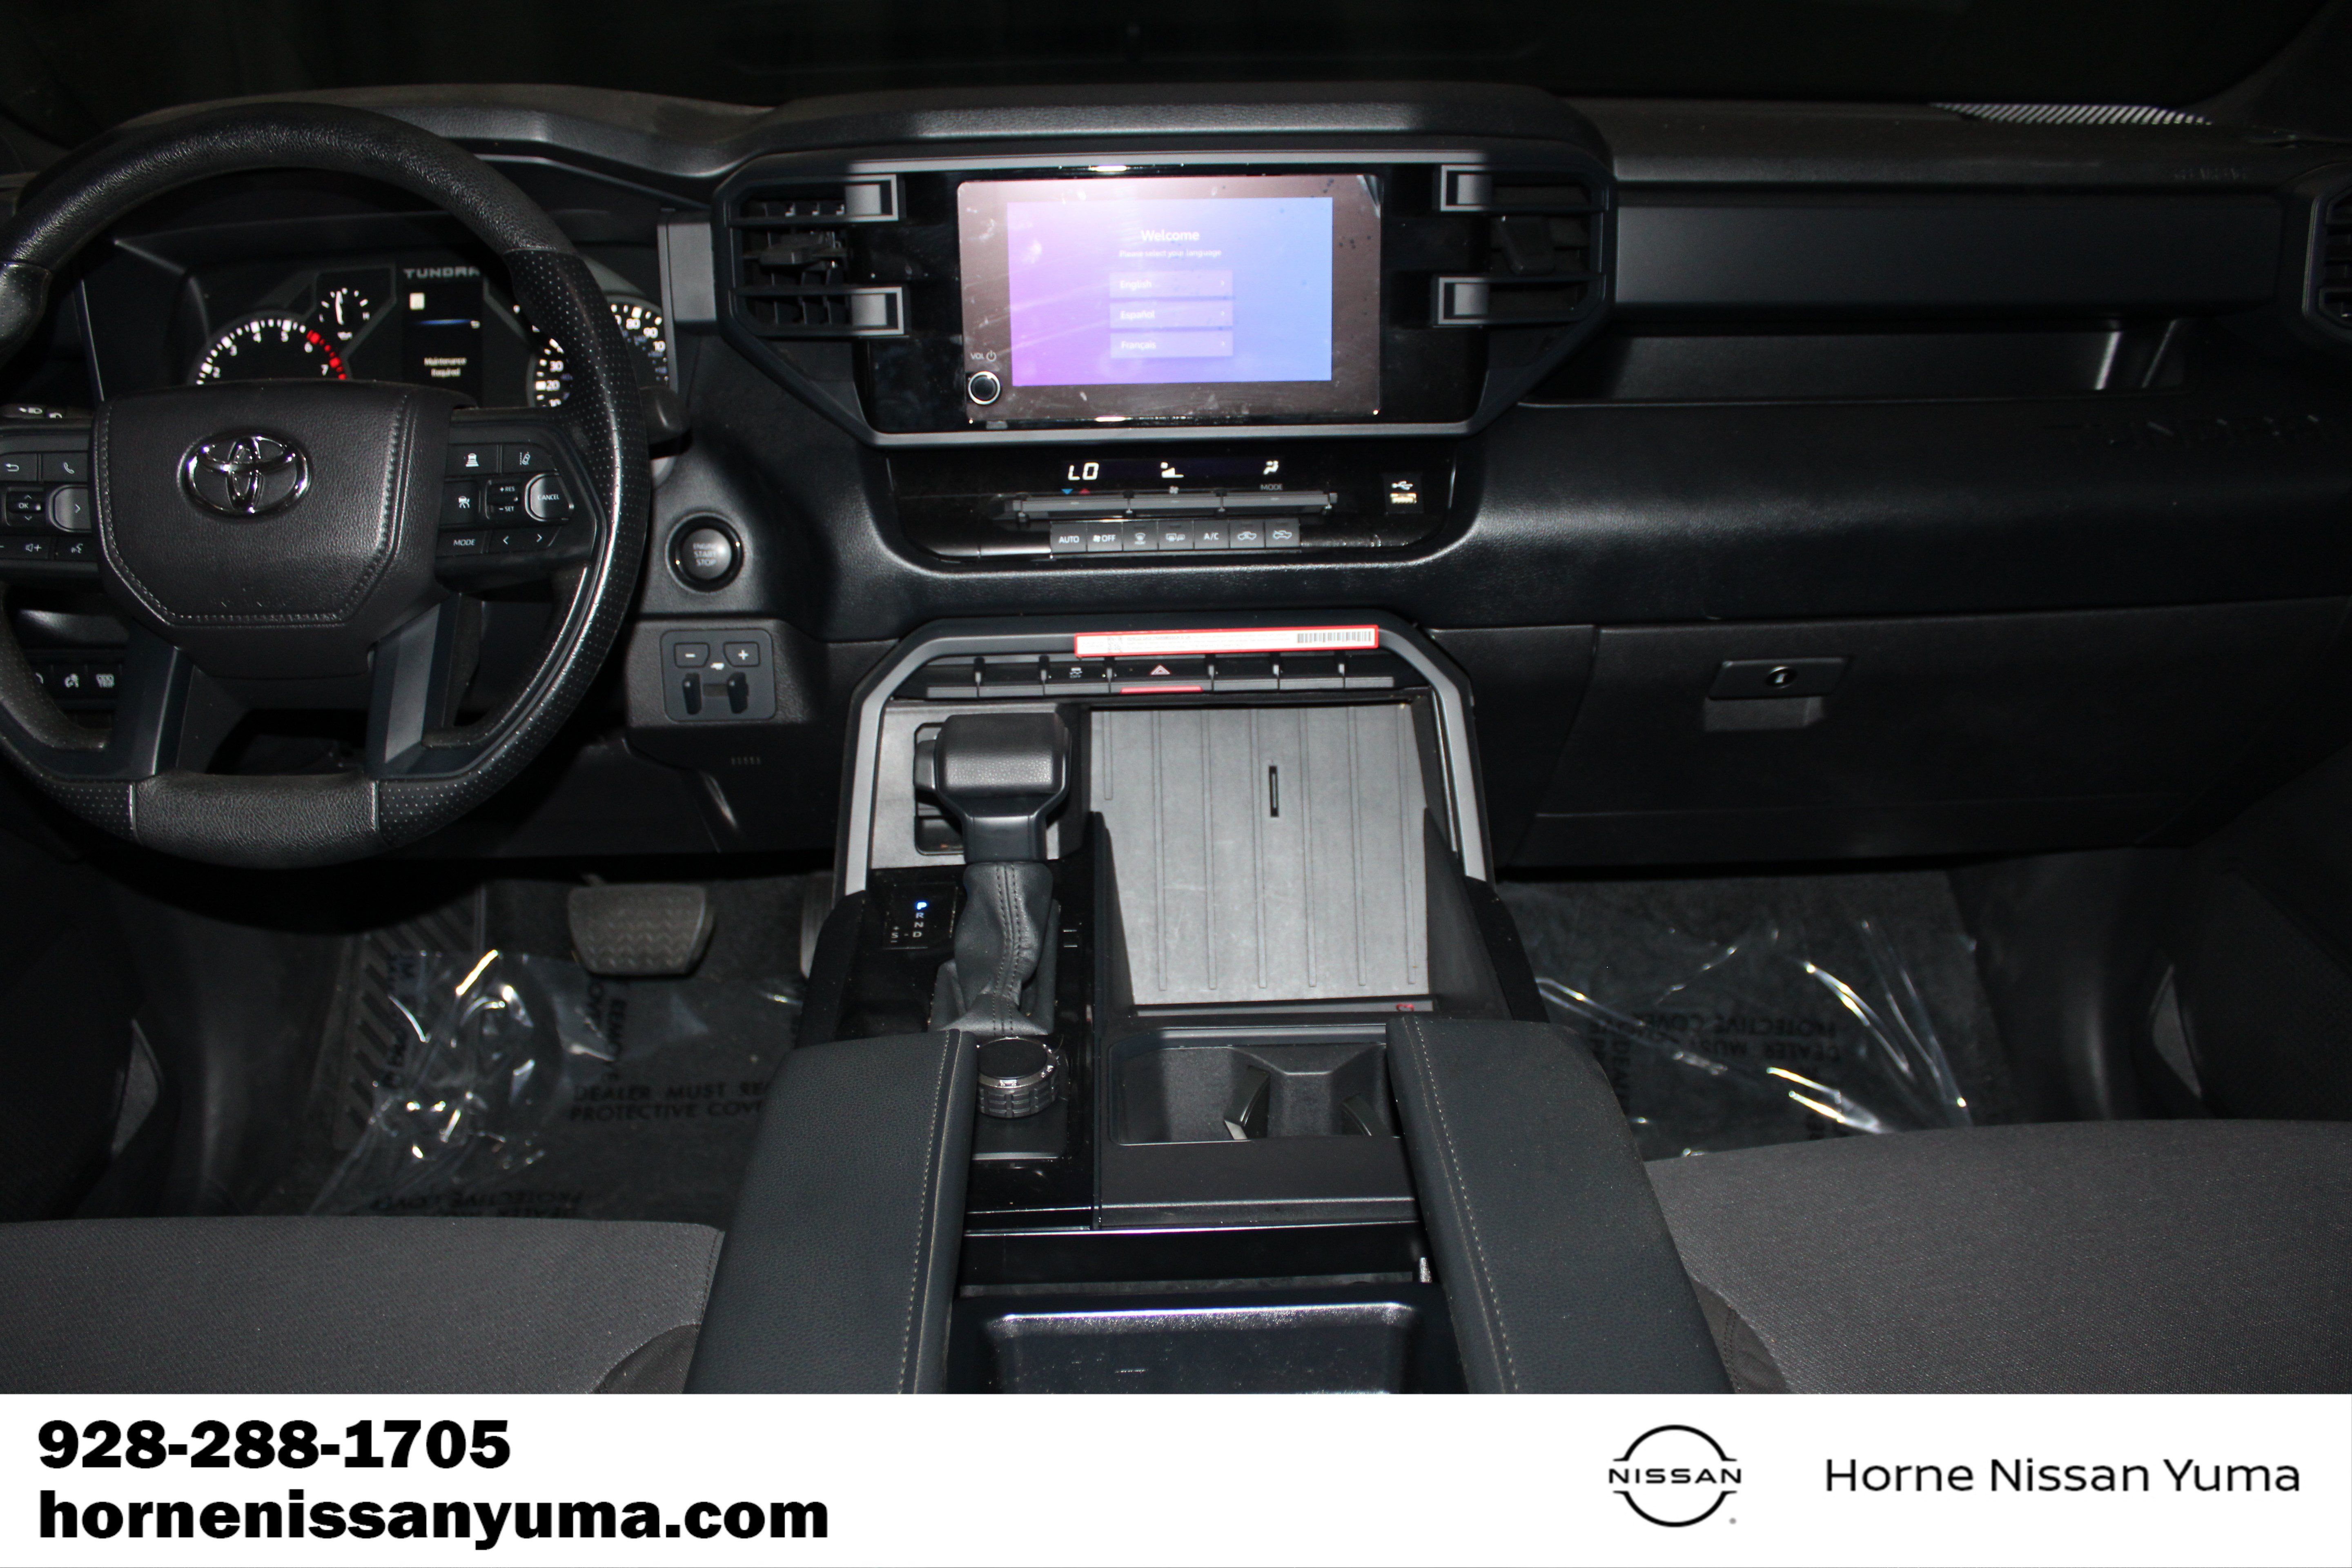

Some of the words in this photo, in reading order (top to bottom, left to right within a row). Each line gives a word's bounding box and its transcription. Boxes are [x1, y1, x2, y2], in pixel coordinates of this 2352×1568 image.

[1141, 229, 1200, 241] Welcome
[1186, 249, 1222, 258] language
[403, 266, 480, 279] TUNDRA
[1120, 280, 1152, 290] English
[1120, 310, 1155, 321] Español
[626, 318, 641, 330] 80
[281, 331, 289, 342] 5
[643, 327, 658, 339] 90
[229, 345, 238, 356] 3
[1121, 340, 1156, 351] Français
[550, 360, 564, 372] 30
[213, 366, 220, 378] 2
[546, 380, 560, 391] 20
[1068, 462, 1099, 481] LO
[1058, 535, 1080, 543] AUTO
[1204, 532, 1219, 541] A/C
[917, 902, 927, 910] P
[574, 1084, 651, 1104] DEALER
[665, 1082, 726, 1100] MUST
[569, 1102, 696, 1122] PROTECTIVE
